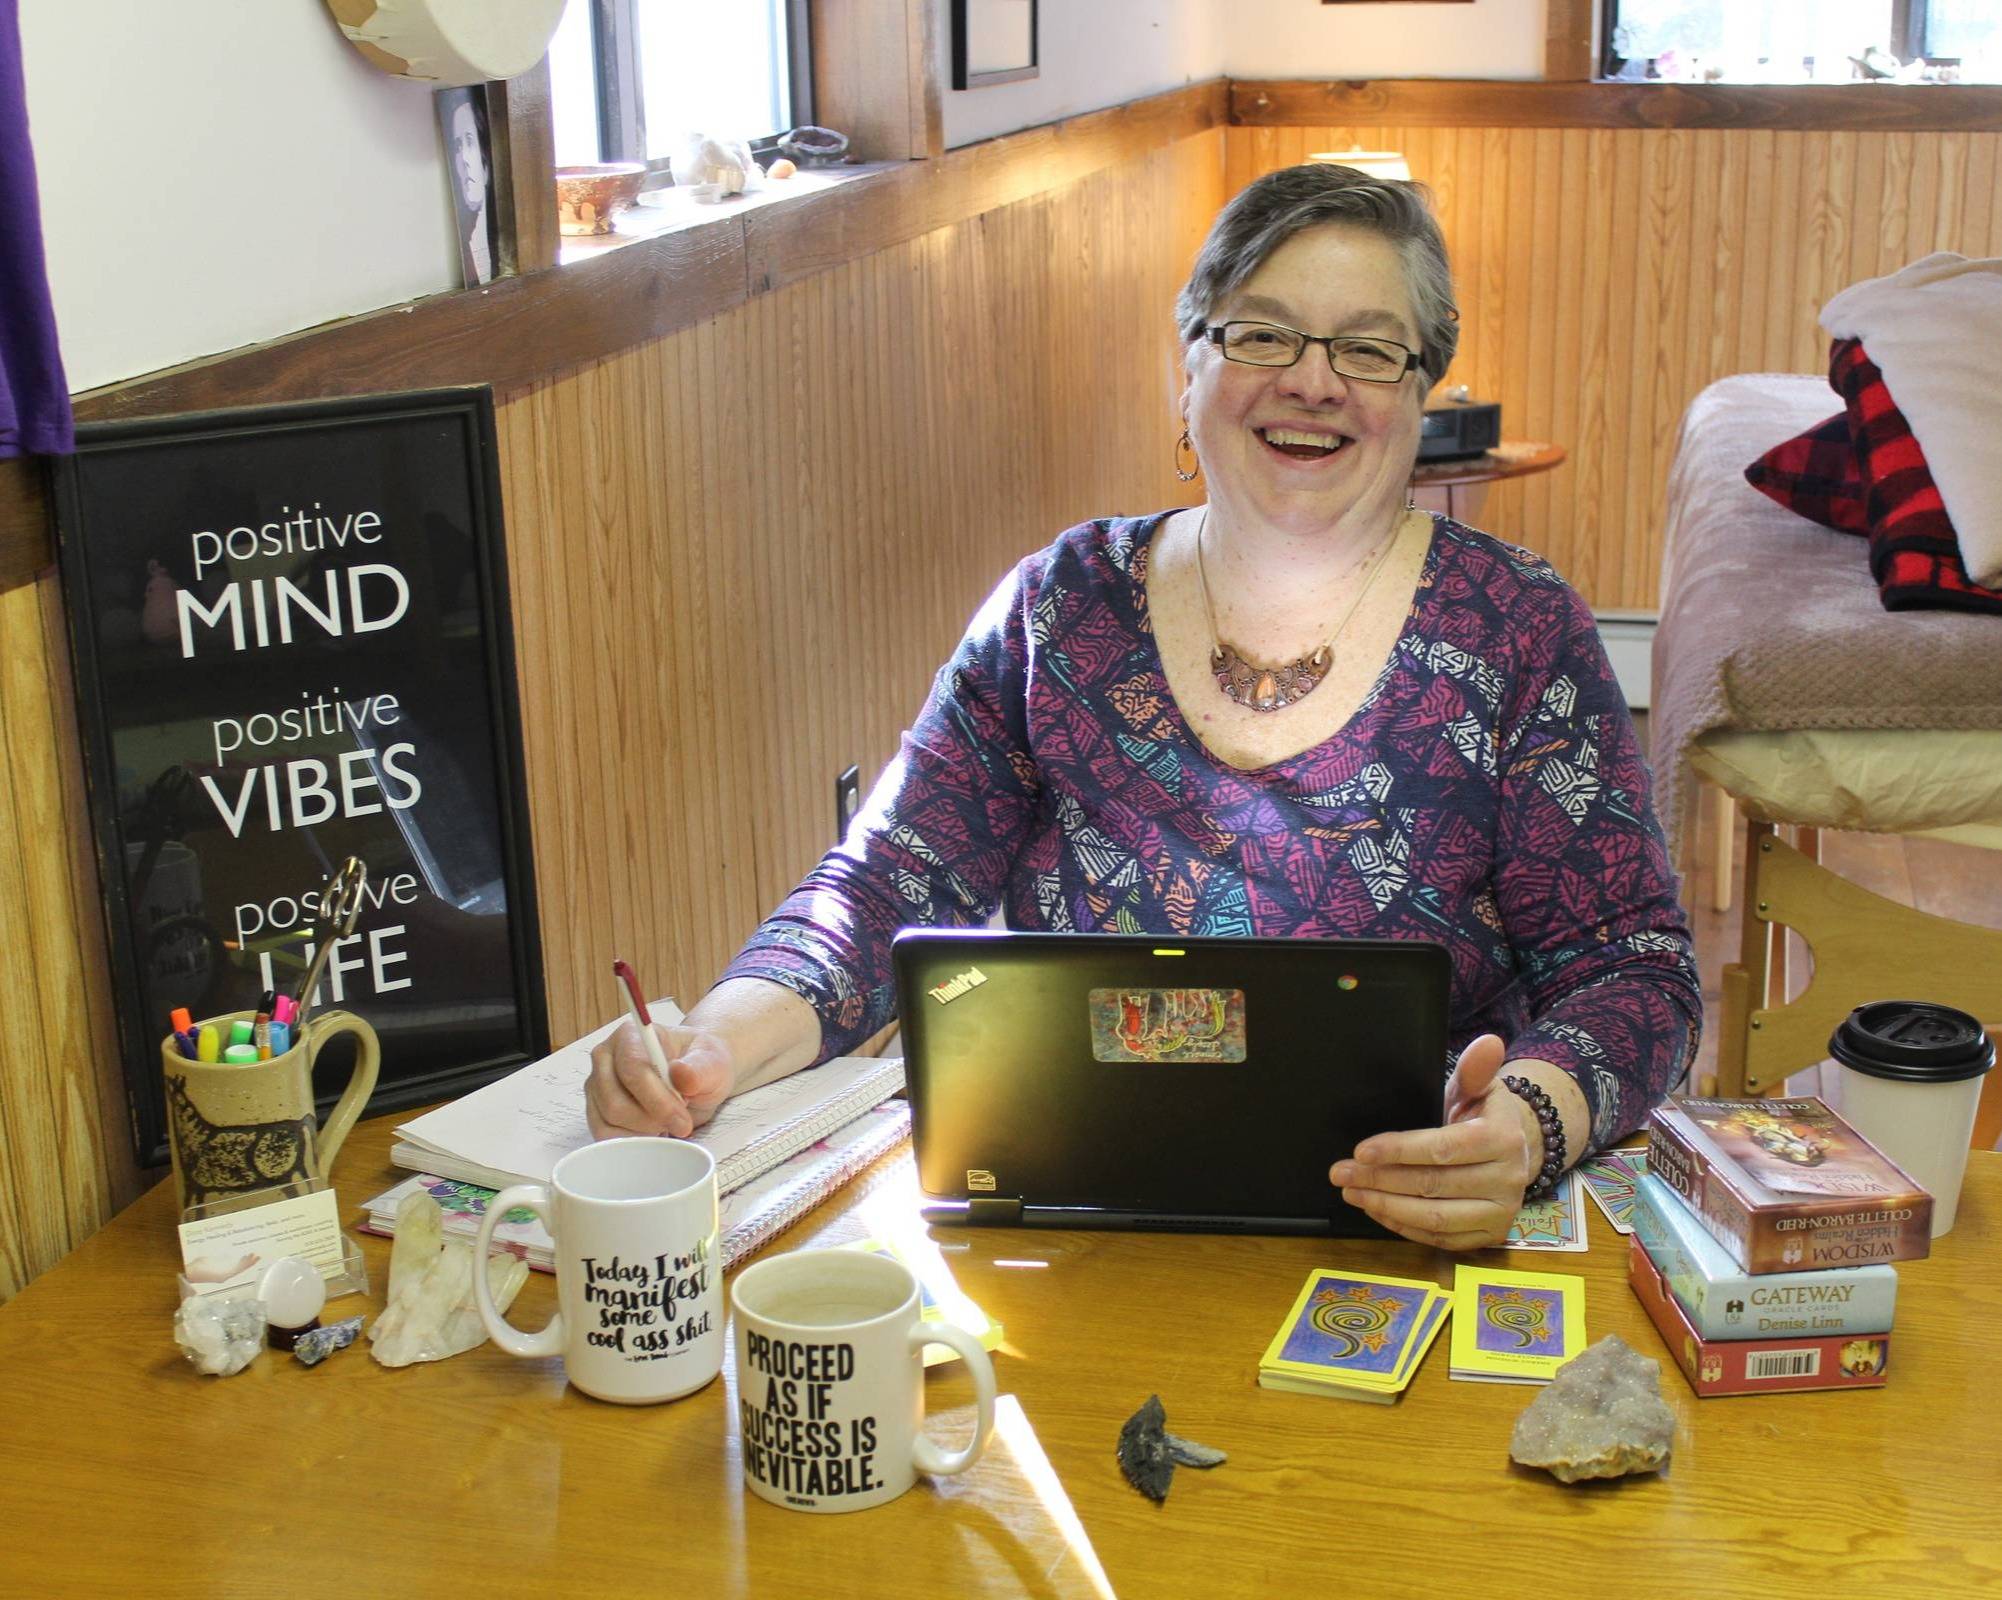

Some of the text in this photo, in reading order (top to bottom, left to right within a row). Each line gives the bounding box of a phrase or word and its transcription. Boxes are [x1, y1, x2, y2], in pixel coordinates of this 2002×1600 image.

[192, 502, 383, 581] positive
[176, 563, 411, 659] MIND
[213, 686, 400, 768] positive
[199, 742, 422, 838] VIBES
[235, 872, 418, 950] posve
[928, 966, 988, 1004] ThinkPad
[1648, 1143, 1689, 1196] COLETTE
[1776, 1208, 1912, 1231] COLETTE BARON-REID
[581, 1256, 649, 1288] Today
[655, 1253, 668, 1281] I
[1813, 1242, 1895, 1261] WISDOM
[585, 1263, 709, 1321] manifest
[1750, 1285, 1855, 1305] GATEWAY
[587, 1311, 713, 1353] cool ass shit
[600, 1308, 657, 1328] some
[1758, 1317, 1807, 1331] Denise
[1812, 1315, 1844, 1329] Linn
[747, 1329, 855, 1381] PROCEED
[766, 1377, 832, 1420] AS IF
[742, 1398, 876, 1458] SUCCESS IS
